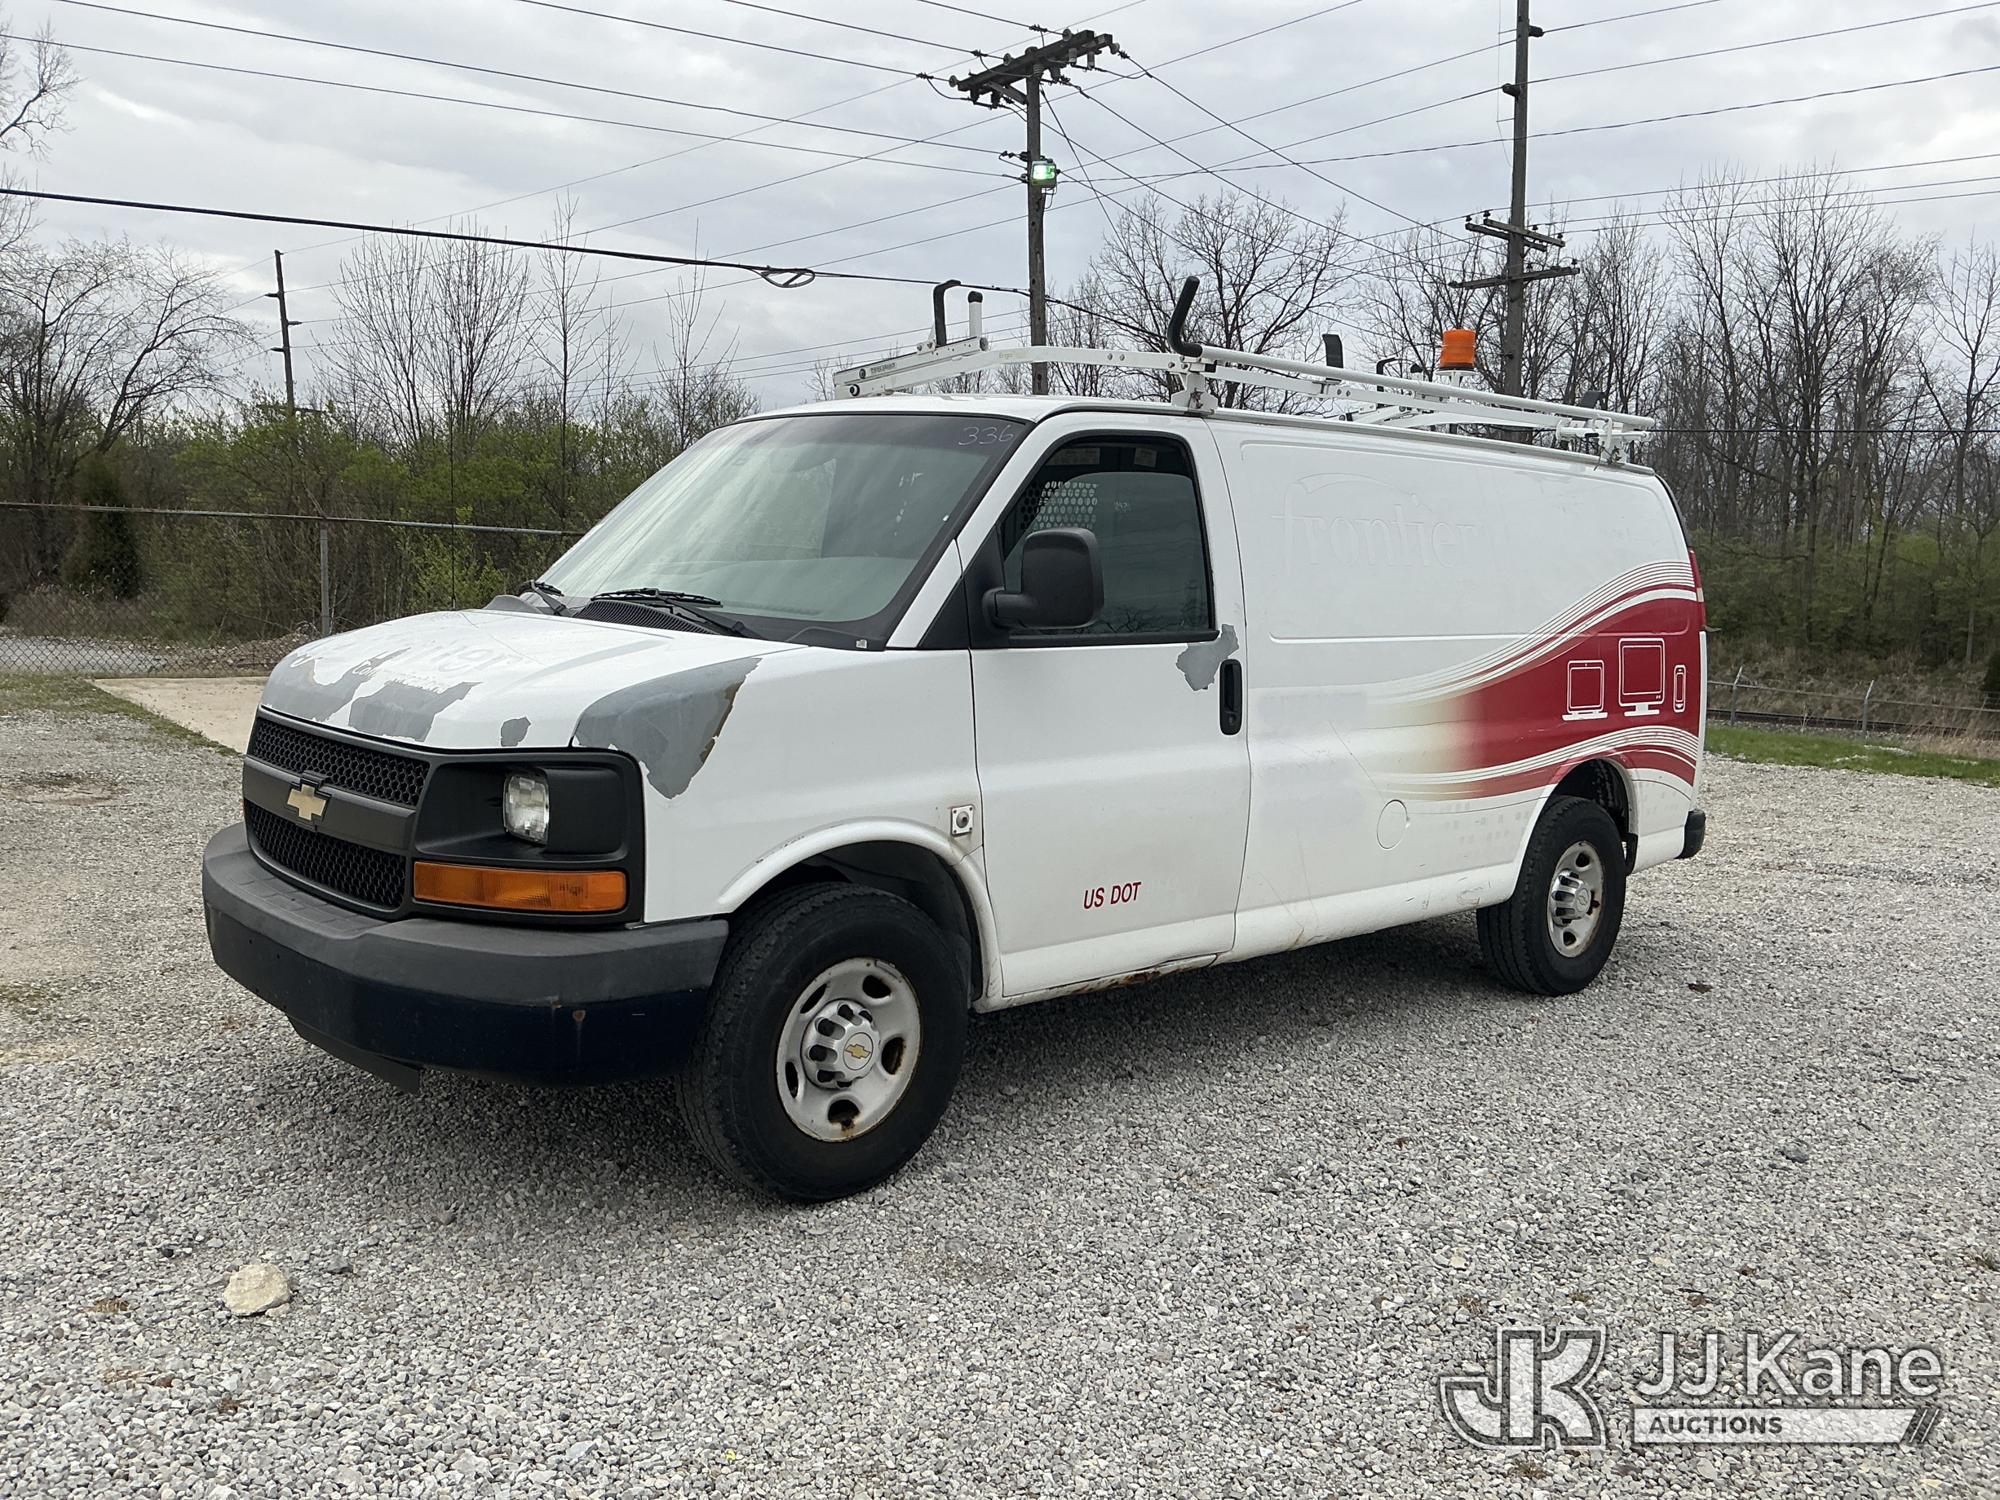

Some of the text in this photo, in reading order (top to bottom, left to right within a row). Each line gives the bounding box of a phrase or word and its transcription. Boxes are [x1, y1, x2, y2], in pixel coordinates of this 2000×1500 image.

[958, 424, 1014, 446] 336
[1083, 881, 1142, 910] US DOT
